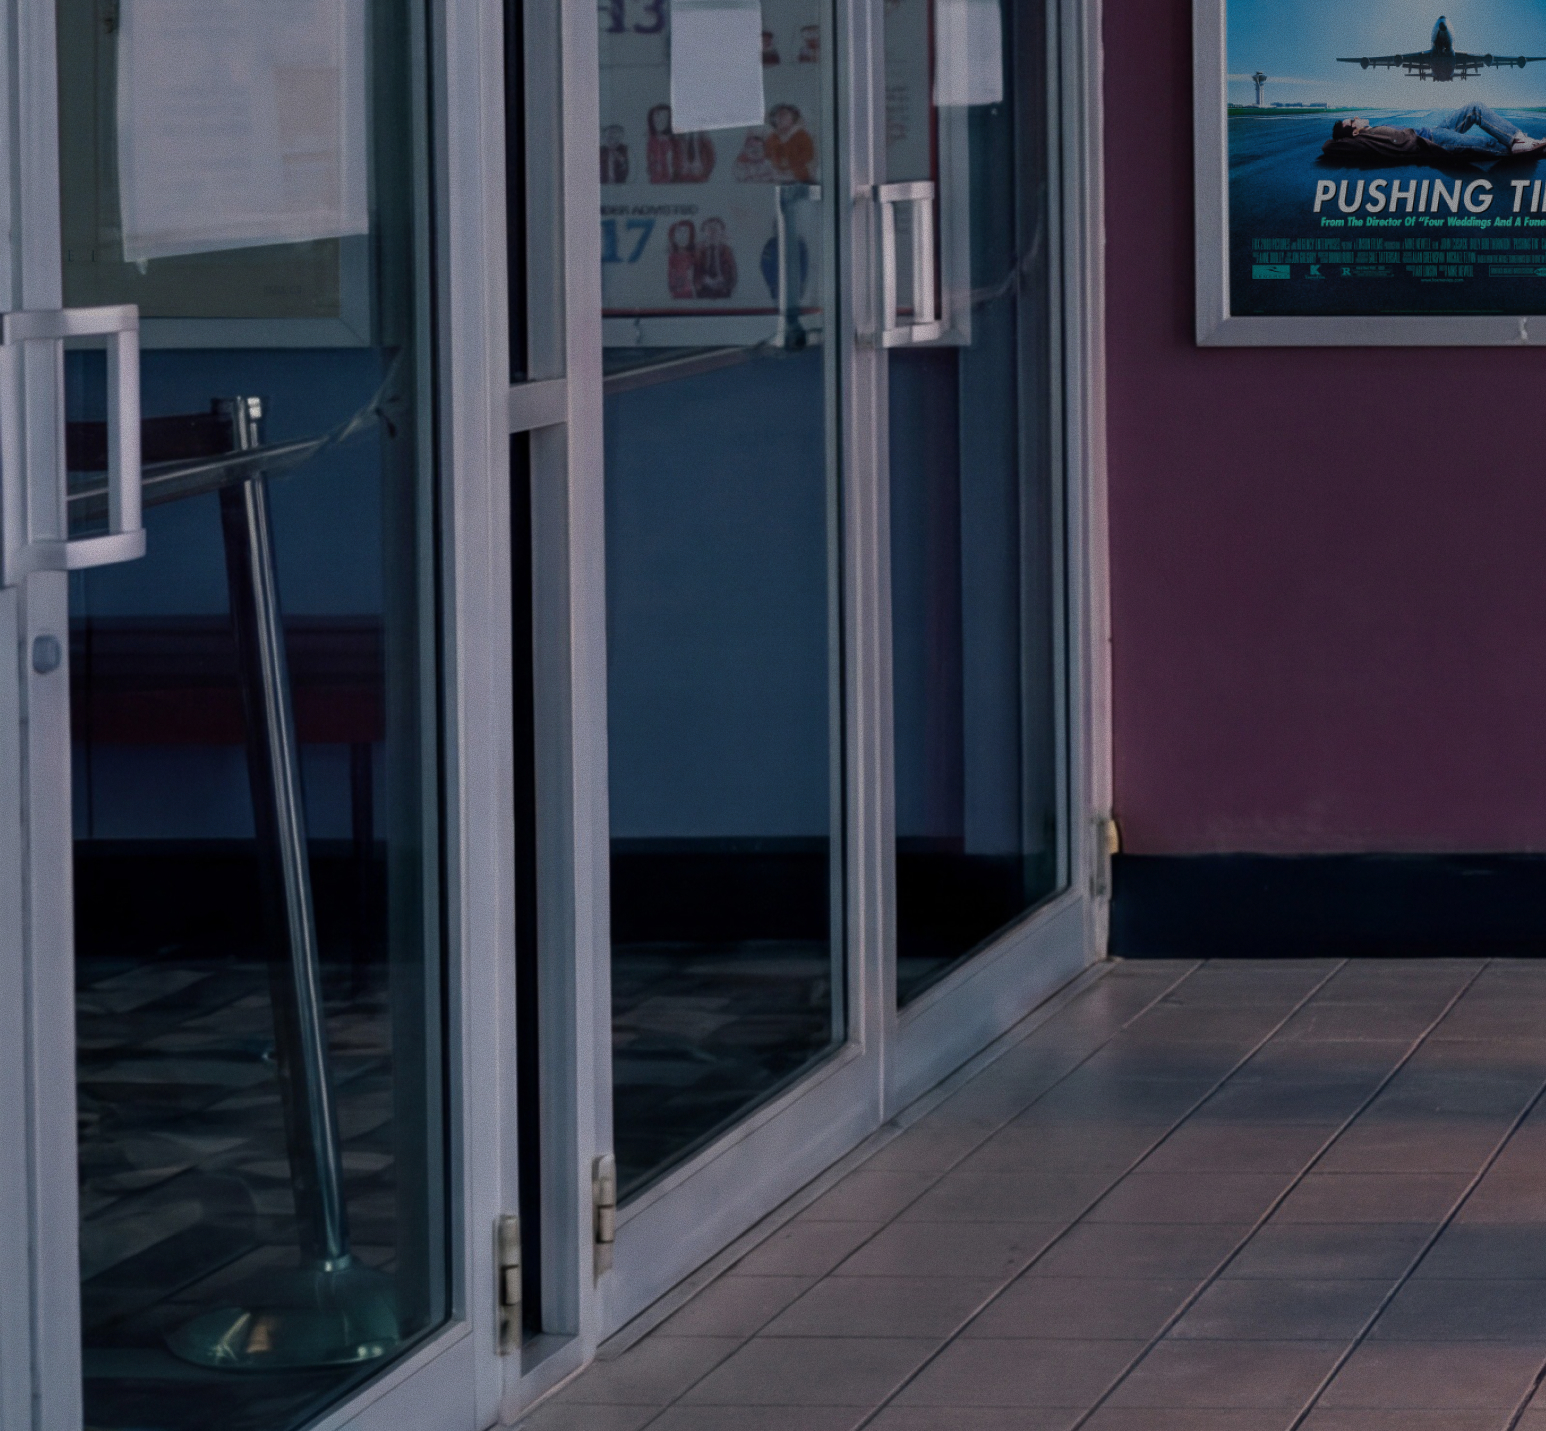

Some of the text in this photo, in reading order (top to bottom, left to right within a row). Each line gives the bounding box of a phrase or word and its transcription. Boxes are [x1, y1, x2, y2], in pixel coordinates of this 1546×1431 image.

[1313, 178, 1494, 214] PUSHING
[1321, 216, 1344, 227] From
[1347, 216, 1363, 227] The
[1366, 216, 1402, 227] Director
[1404, 216, 1416, 227] Of
[1447, 216, 1491, 229] Weddings
[1494, 216, 1512, 227] And
[1514, 216, 1523, 227] A
